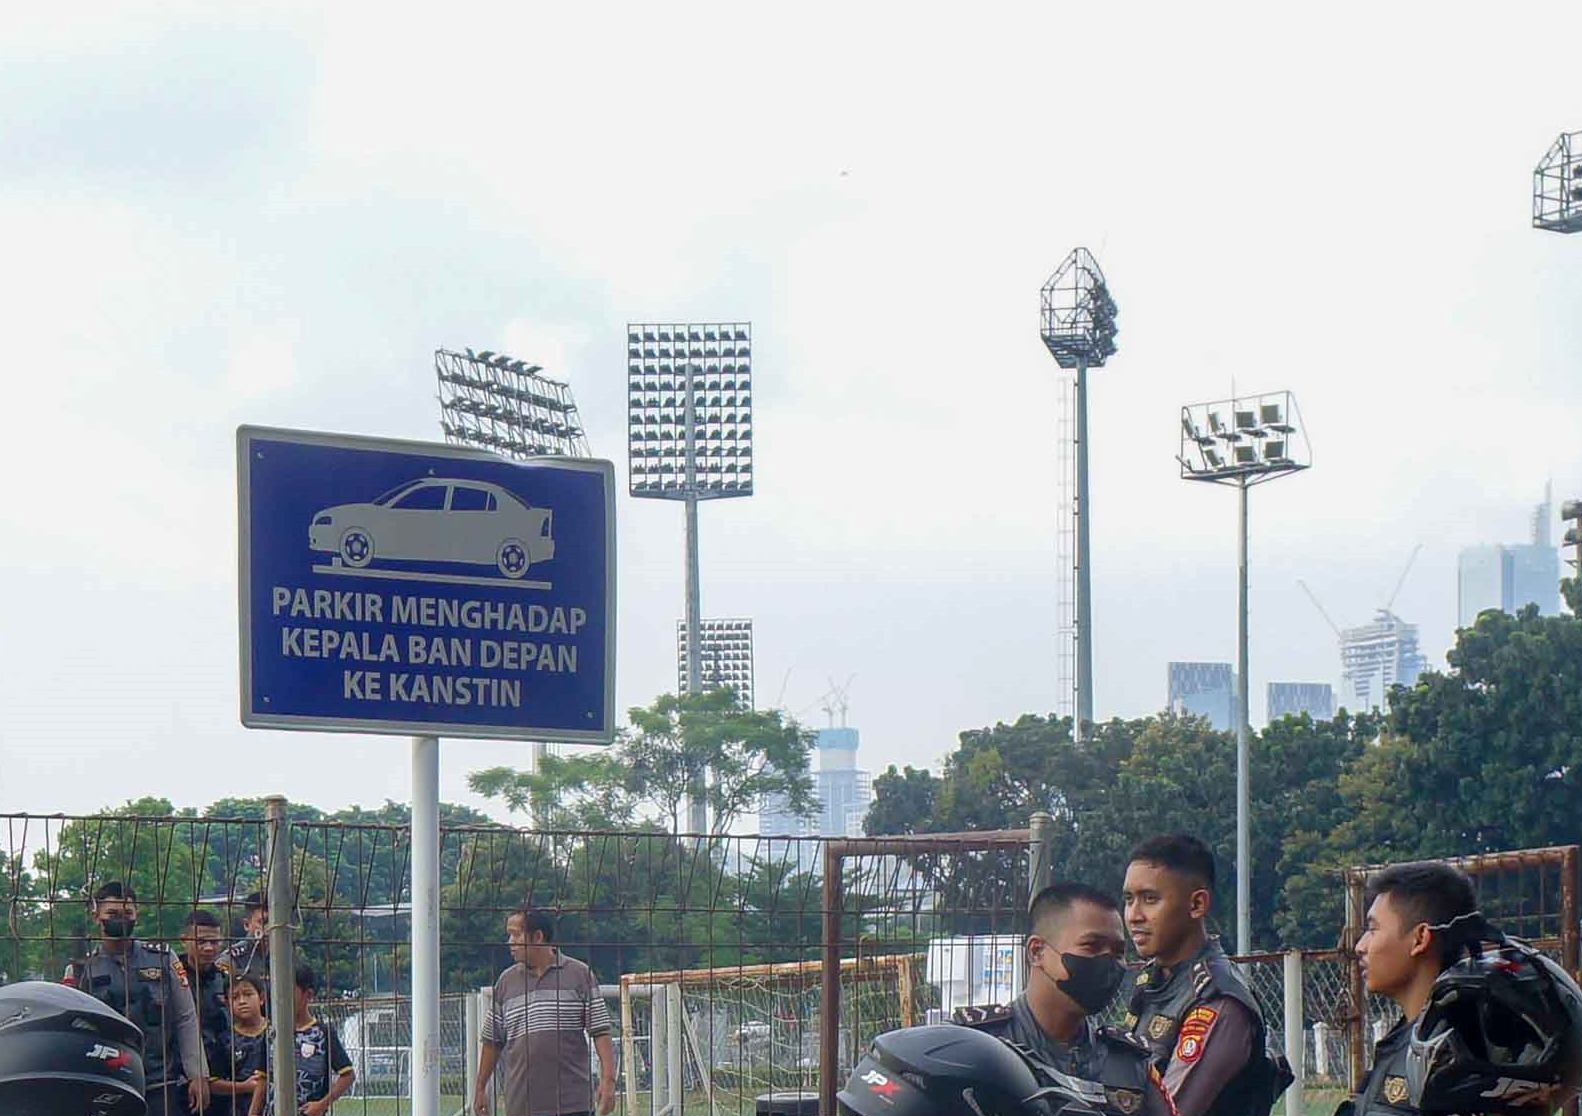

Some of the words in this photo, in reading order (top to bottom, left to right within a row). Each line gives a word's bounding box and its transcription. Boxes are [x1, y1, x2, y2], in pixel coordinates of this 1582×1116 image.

[272, 587, 383, 623] PARKIR
[391, 596, 587, 635] MENGHADAP
[281, 628, 400, 662] KEPALA
[408, 635, 472, 667] BAN
[480, 640, 577, 673] DEPAN
[343, 670, 381, 701] KE
[389, 673, 521, 708] KANSTIN
[861, 1070, 901, 1094] JPX
